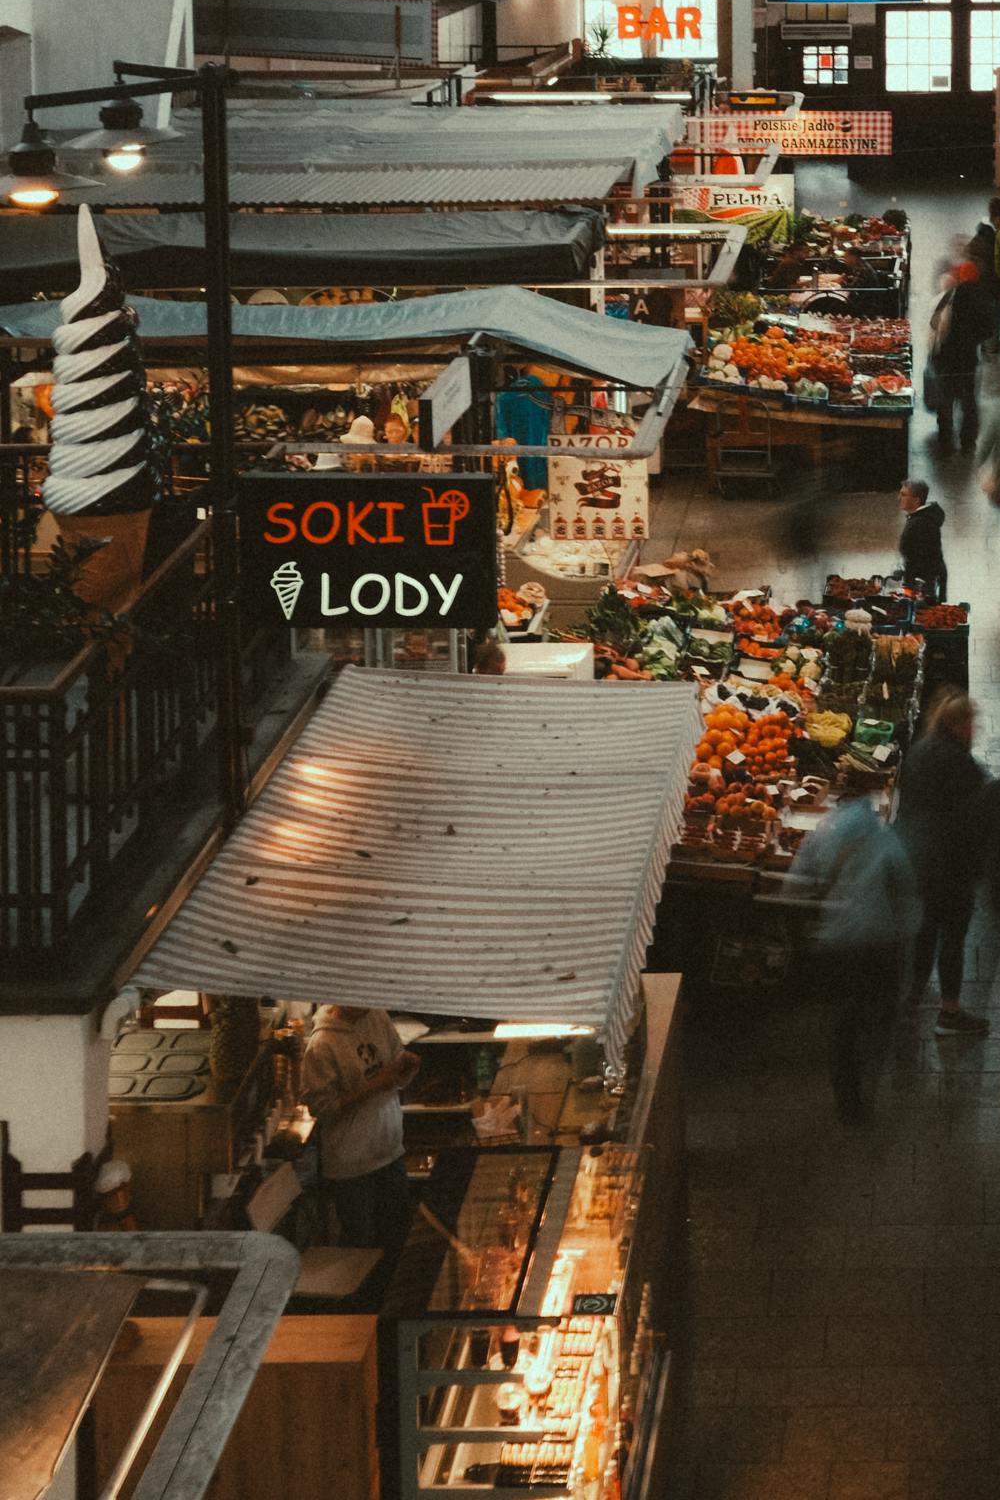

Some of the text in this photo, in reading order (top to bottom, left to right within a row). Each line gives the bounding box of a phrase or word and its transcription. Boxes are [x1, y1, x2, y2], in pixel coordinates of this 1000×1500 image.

[617, 6, 703, 40] BAR
[753, 118, 835, 134] Polskie Jadło
[263, 501, 405, 546] SOKI
[320, 572, 464, 617] LODY
